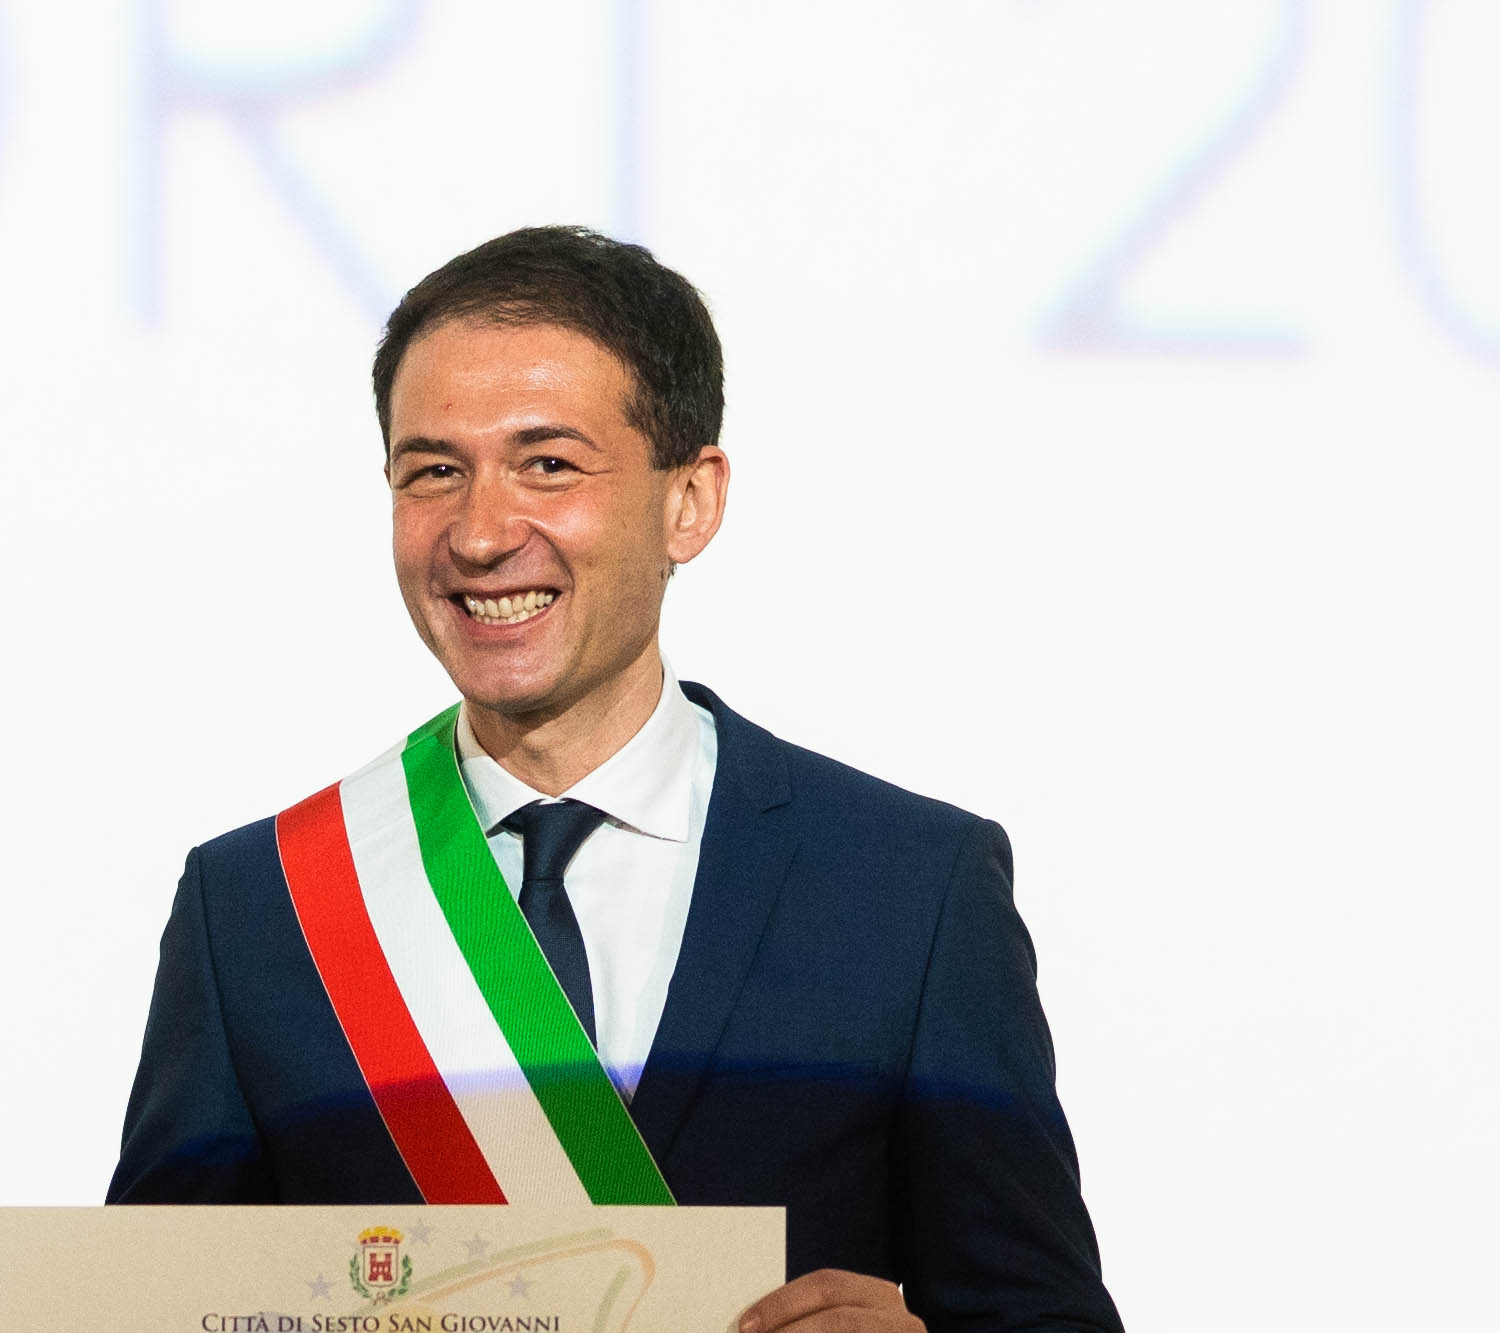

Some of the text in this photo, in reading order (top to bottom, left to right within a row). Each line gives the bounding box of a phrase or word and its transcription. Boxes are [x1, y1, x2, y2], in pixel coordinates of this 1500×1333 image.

[278, 1316, 301, 1333] DI
[312, 1313, 379, 1333] SESTO
[388, 1313, 431, 1333] SAN
[441, 1315, 560, 1333] GIOVANNI
